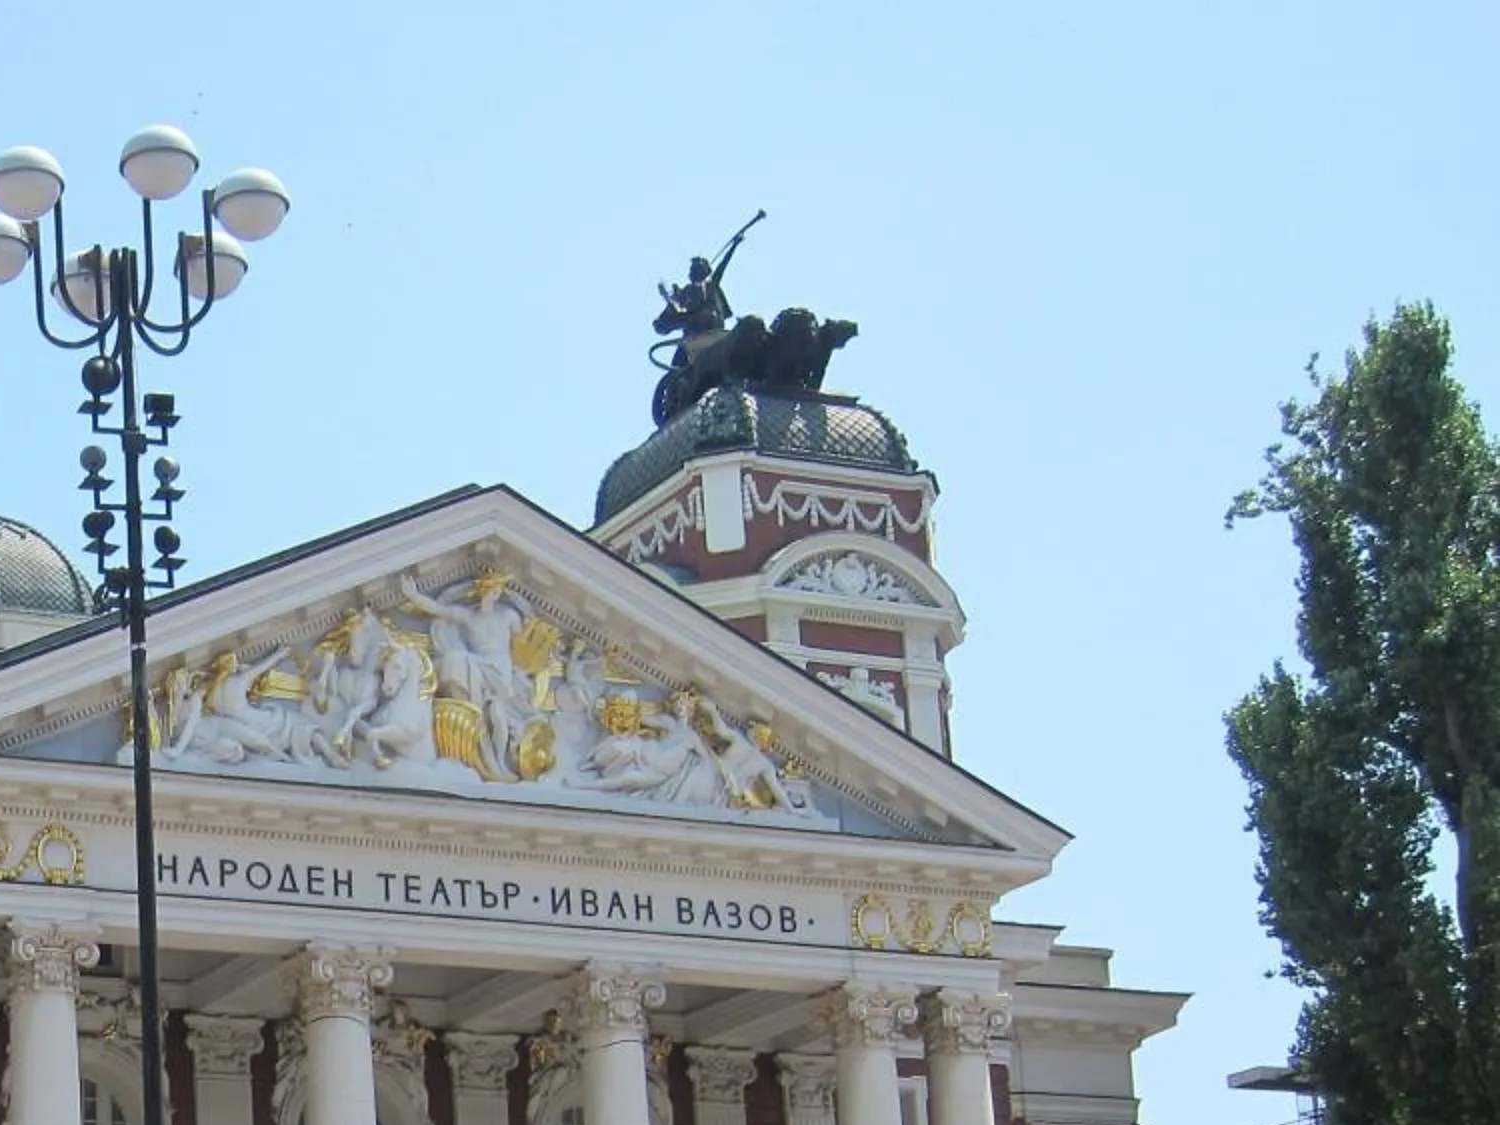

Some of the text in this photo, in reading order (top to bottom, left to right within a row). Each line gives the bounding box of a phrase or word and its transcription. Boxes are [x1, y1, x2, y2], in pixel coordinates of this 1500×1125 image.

[157, 852, 354, 899] НАРОДЕН
[376, 872, 521, 911] ТЕАТЪР
[550, 886, 654, 923] ИВАН
